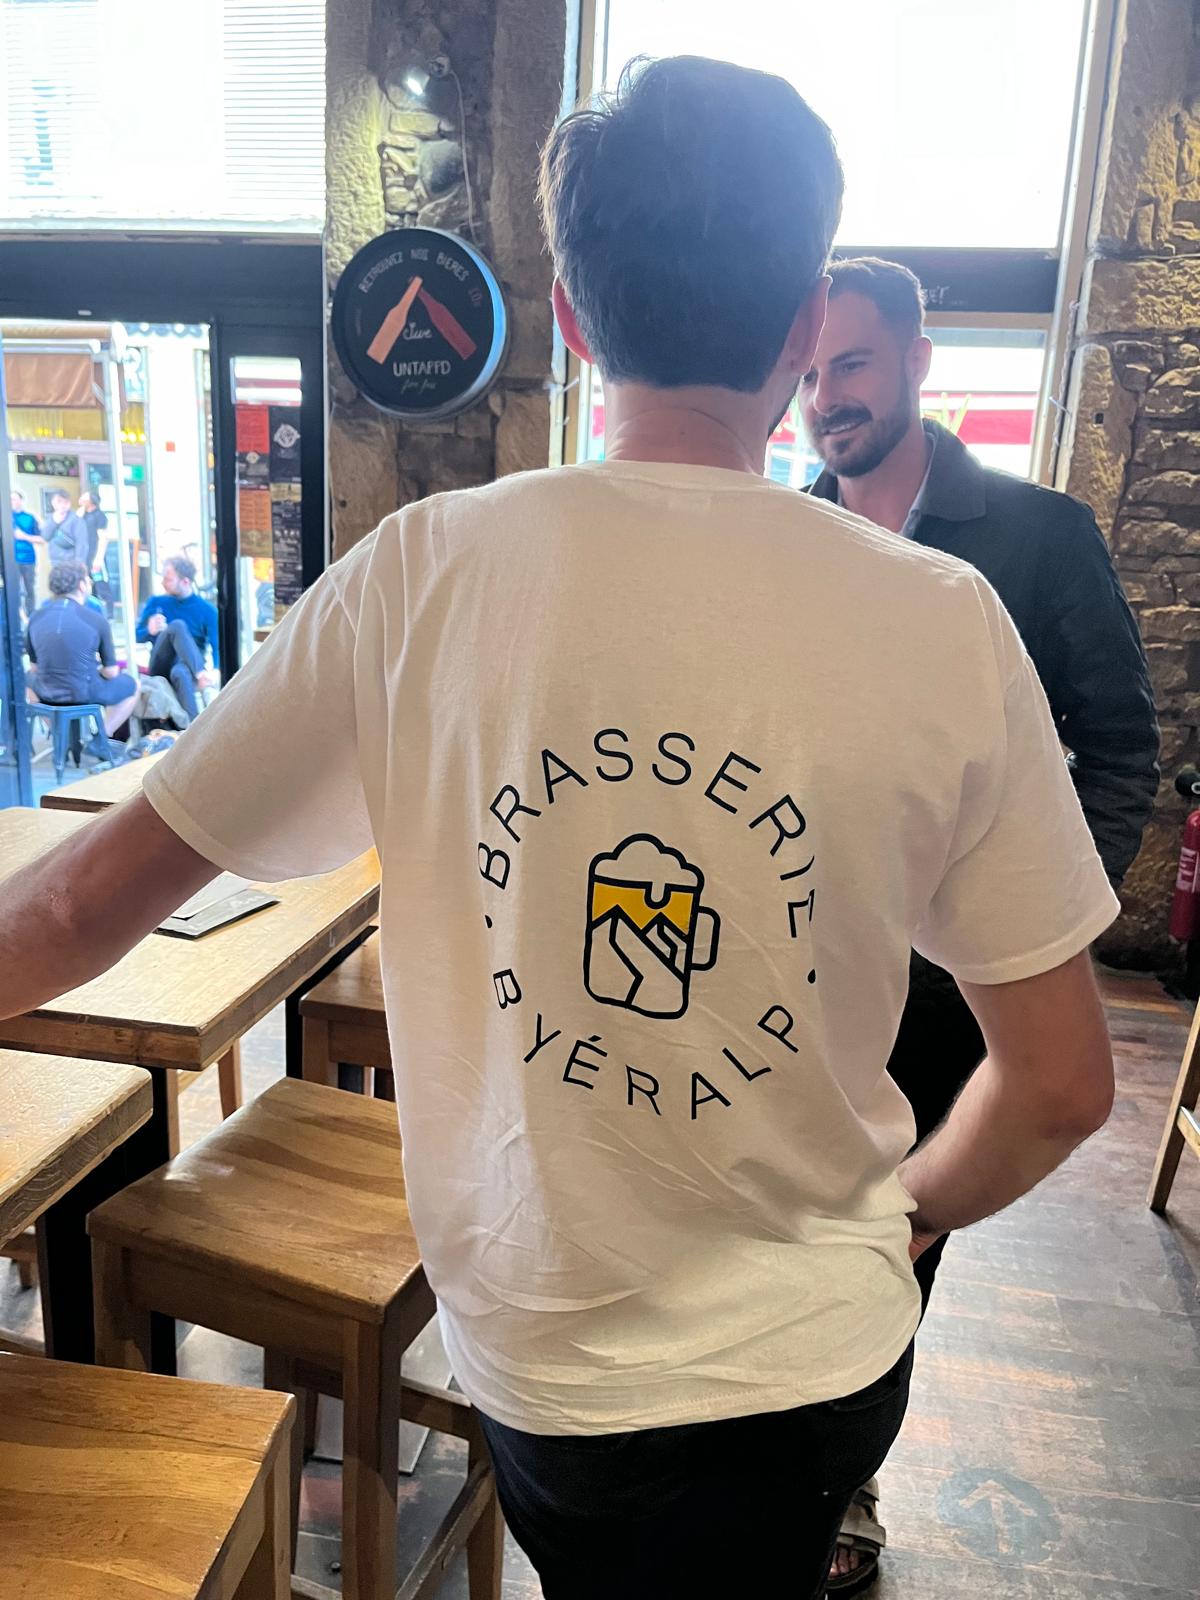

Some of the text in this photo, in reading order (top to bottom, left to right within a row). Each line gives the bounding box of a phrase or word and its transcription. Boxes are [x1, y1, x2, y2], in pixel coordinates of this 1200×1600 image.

[392, 360, 451, 377] UNTAPPD
[478, 728, 816, 938] BRASSERIE
[493, 968, 799, 1120] BYÉRALP
